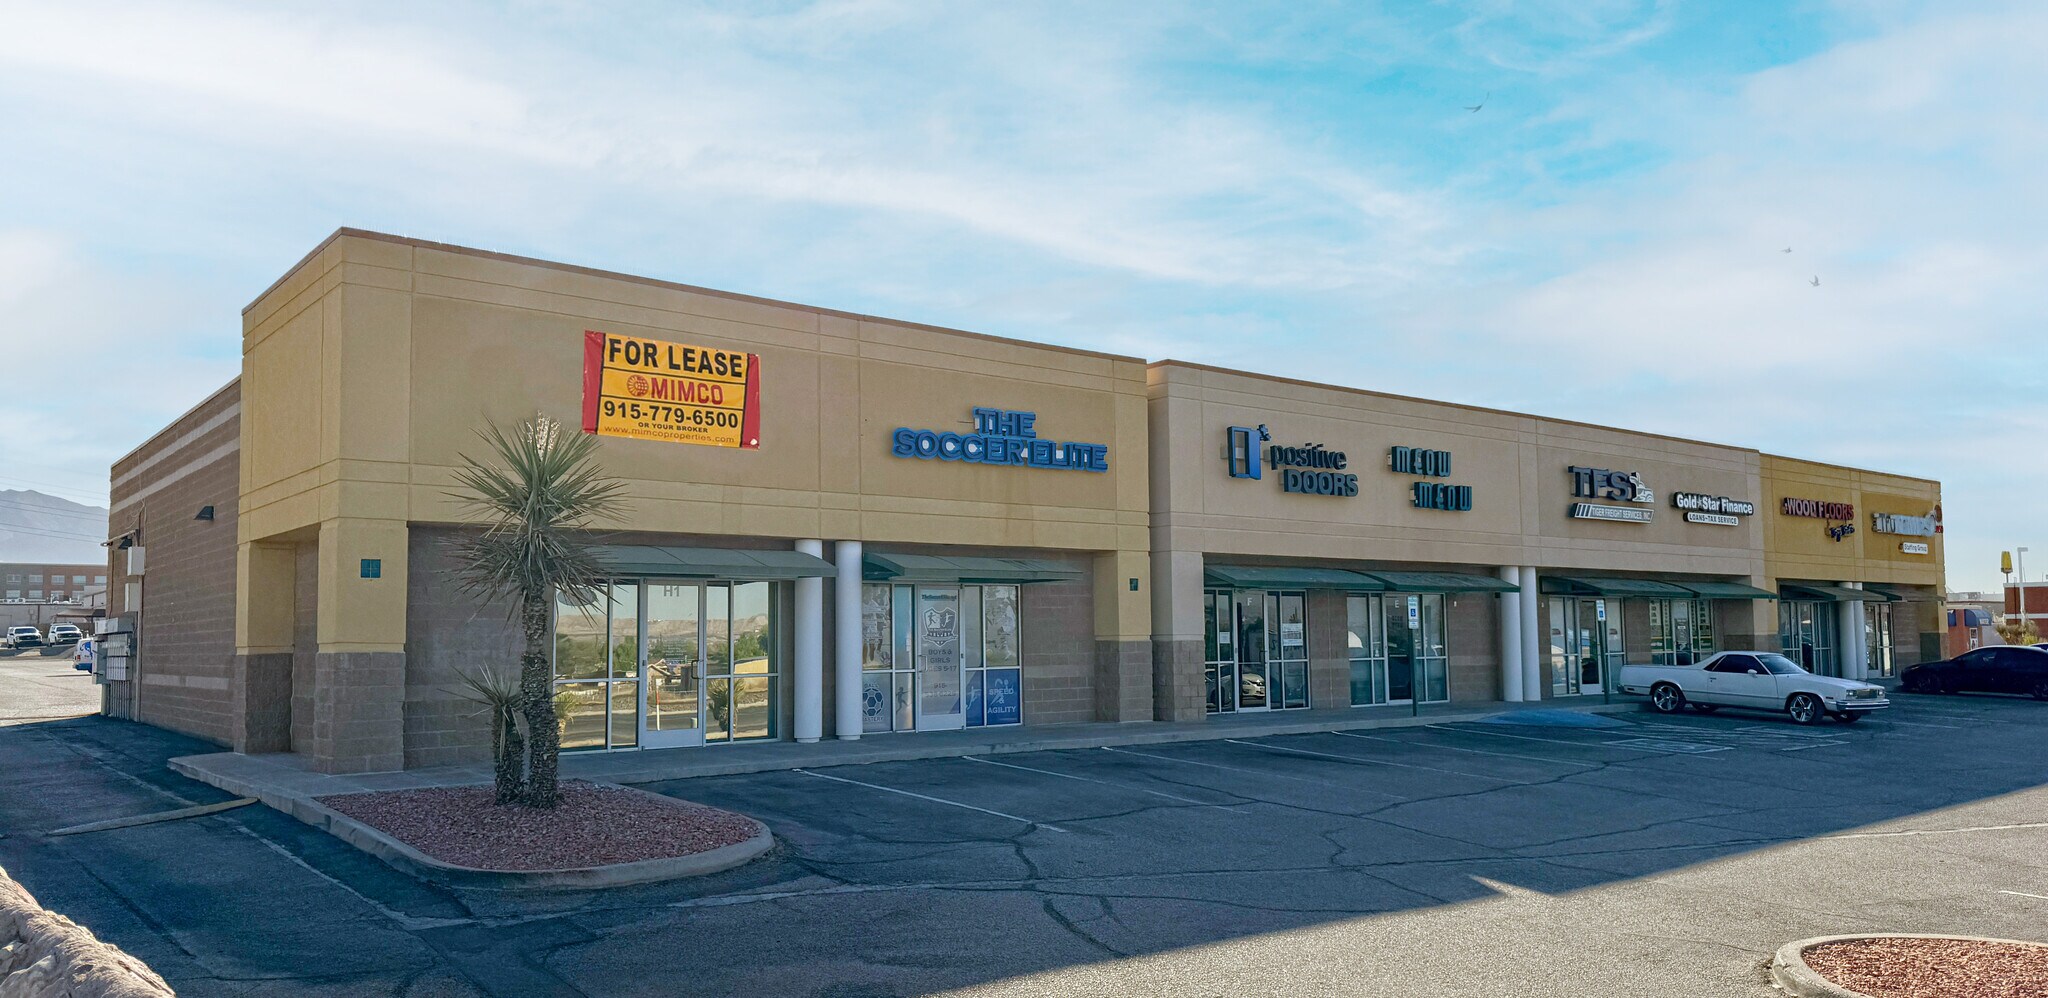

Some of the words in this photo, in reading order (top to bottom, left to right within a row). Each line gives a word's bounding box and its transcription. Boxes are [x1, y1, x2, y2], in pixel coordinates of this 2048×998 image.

[609, 338, 658, 368] FOR
[668, 345, 742, 378] LEASE
[651, 377, 723, 405] MIMCO
[604, 401, 738, 428] 915-779-6500
[972, 406, 1036, 439] THE
[604, 425, 735, 444] www.mimcoproperties.com
[651, 423, 674, 431] YOUR
[676, 425, 709, 434] BROKER
[892, 427, 1025, 466] SOCCER
[1027, 439, 1108, 473] ELITE
[1270, 442, 1347, 470] positive
[1283, 469, 1359, 497] DOORS
[1567, 465, 1632, 502] TFS
[1592, 507, 1605, 517] TIGER
[1605, 508, 1622, 518] FREIGHT
[1676, 494, 1697, 509] Gold
[1702, 496, 1720, 511] Star
[1721, 498, 1753, 514] Finance
[1786, 498, 1817, 518] WOOD
[1818, 501, 1854, 520] FLOORS
[1717, 516, 1737, 525] SERVICE
[663, 585, 680, 597] H1
[987, 705, 1016, 714] AGILITY
